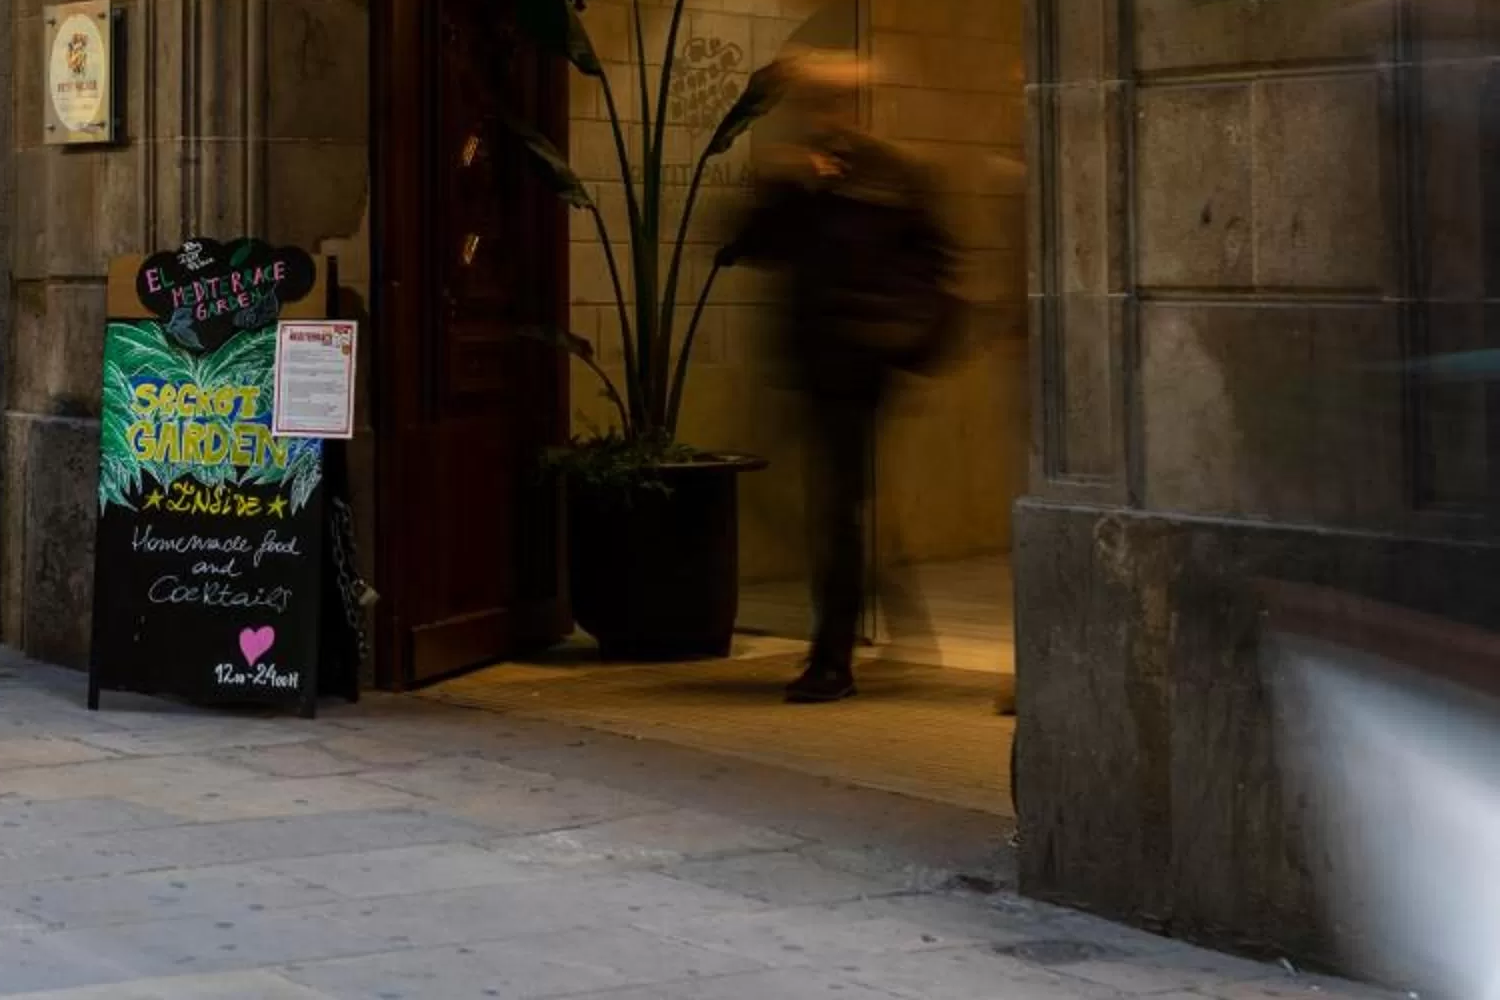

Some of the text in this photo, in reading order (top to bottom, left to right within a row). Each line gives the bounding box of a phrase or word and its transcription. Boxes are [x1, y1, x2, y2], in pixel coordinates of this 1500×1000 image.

[145, 266, 174, 293] EL
[195, 287, 267, 321] GARDEN
[127, 418, 288, 469] GARDEN
[131, 524, 302, 567] Homemade food
[191, 557, 243, 577] and
